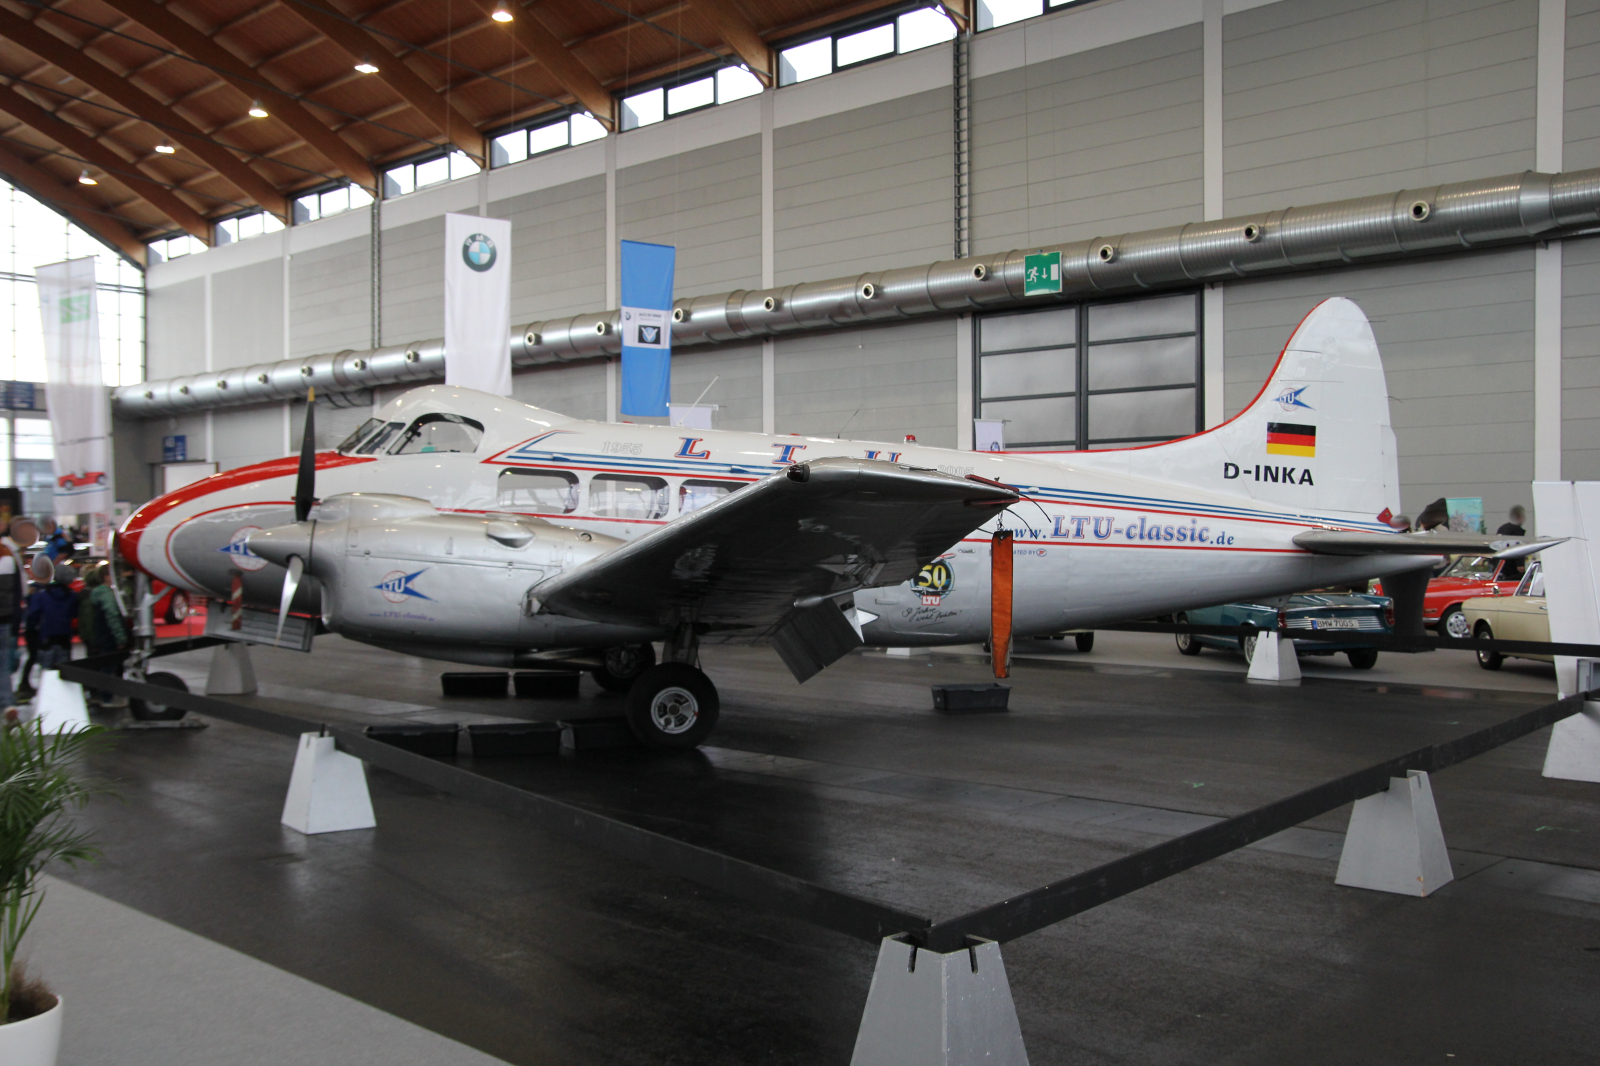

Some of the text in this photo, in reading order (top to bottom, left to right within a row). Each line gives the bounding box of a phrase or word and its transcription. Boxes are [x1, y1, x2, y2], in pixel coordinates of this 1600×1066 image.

[601, 441, 643, 455] 1955
[1224, 462, 1314, 486] D-INKA
[918, 564, 947, 588] 50
[382, 578, 405, 593] LTU
[922, 596, 940, 605] LTU
